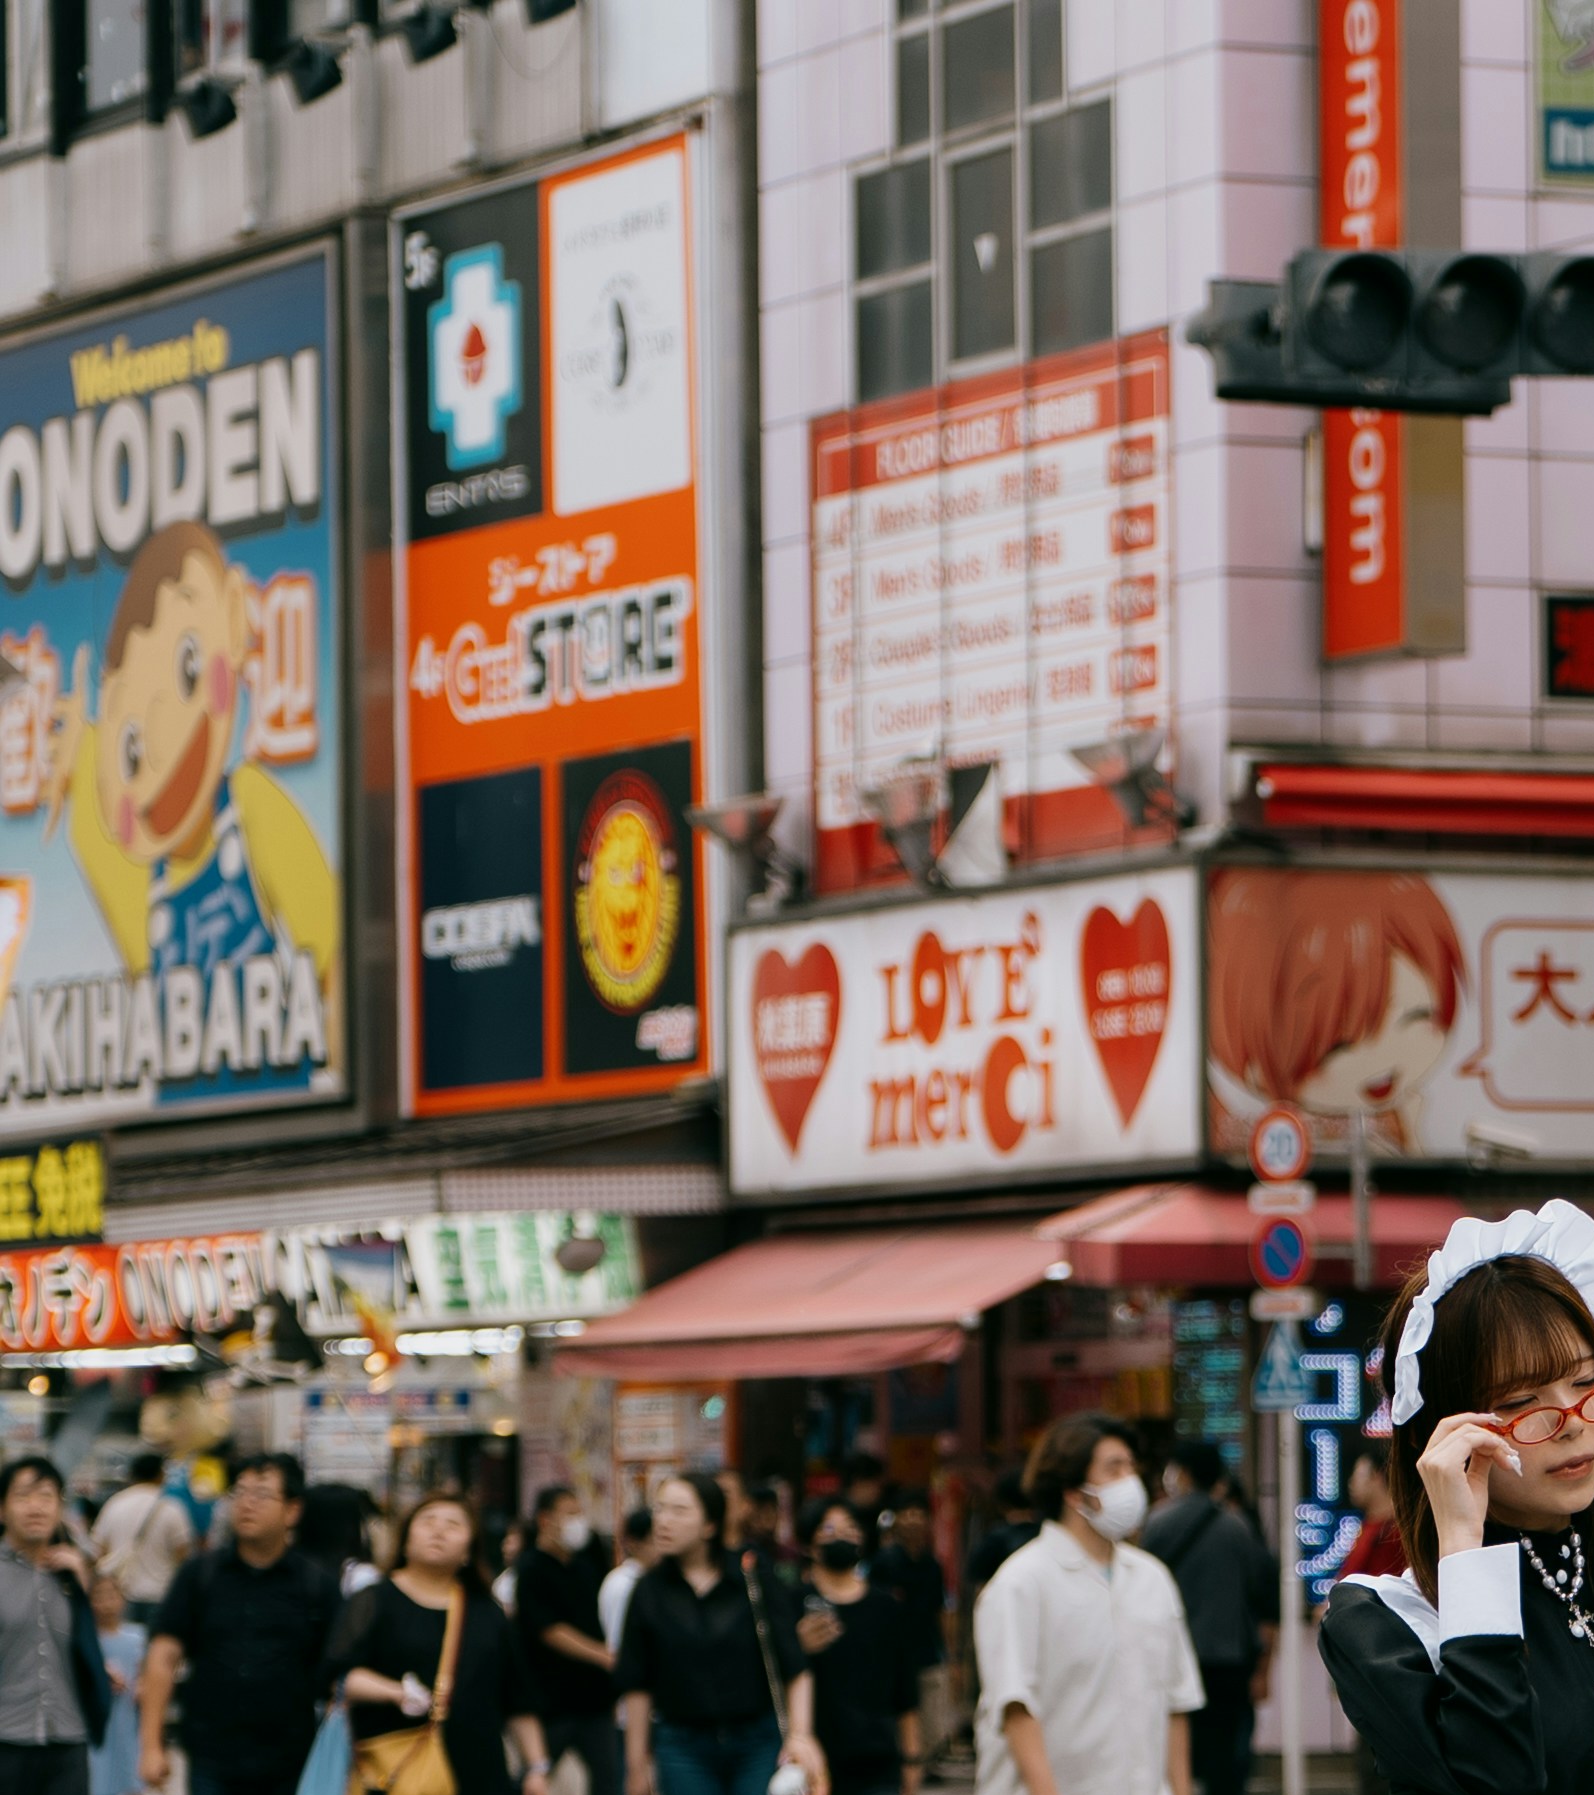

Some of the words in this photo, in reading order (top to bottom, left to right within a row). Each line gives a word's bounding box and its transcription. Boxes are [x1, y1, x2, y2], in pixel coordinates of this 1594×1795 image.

[0, 349, 319, 579] ONODEN
[0, 952, 327, 1097] AKIHABARA
[881, 931, 1033, 1044] LOVE
